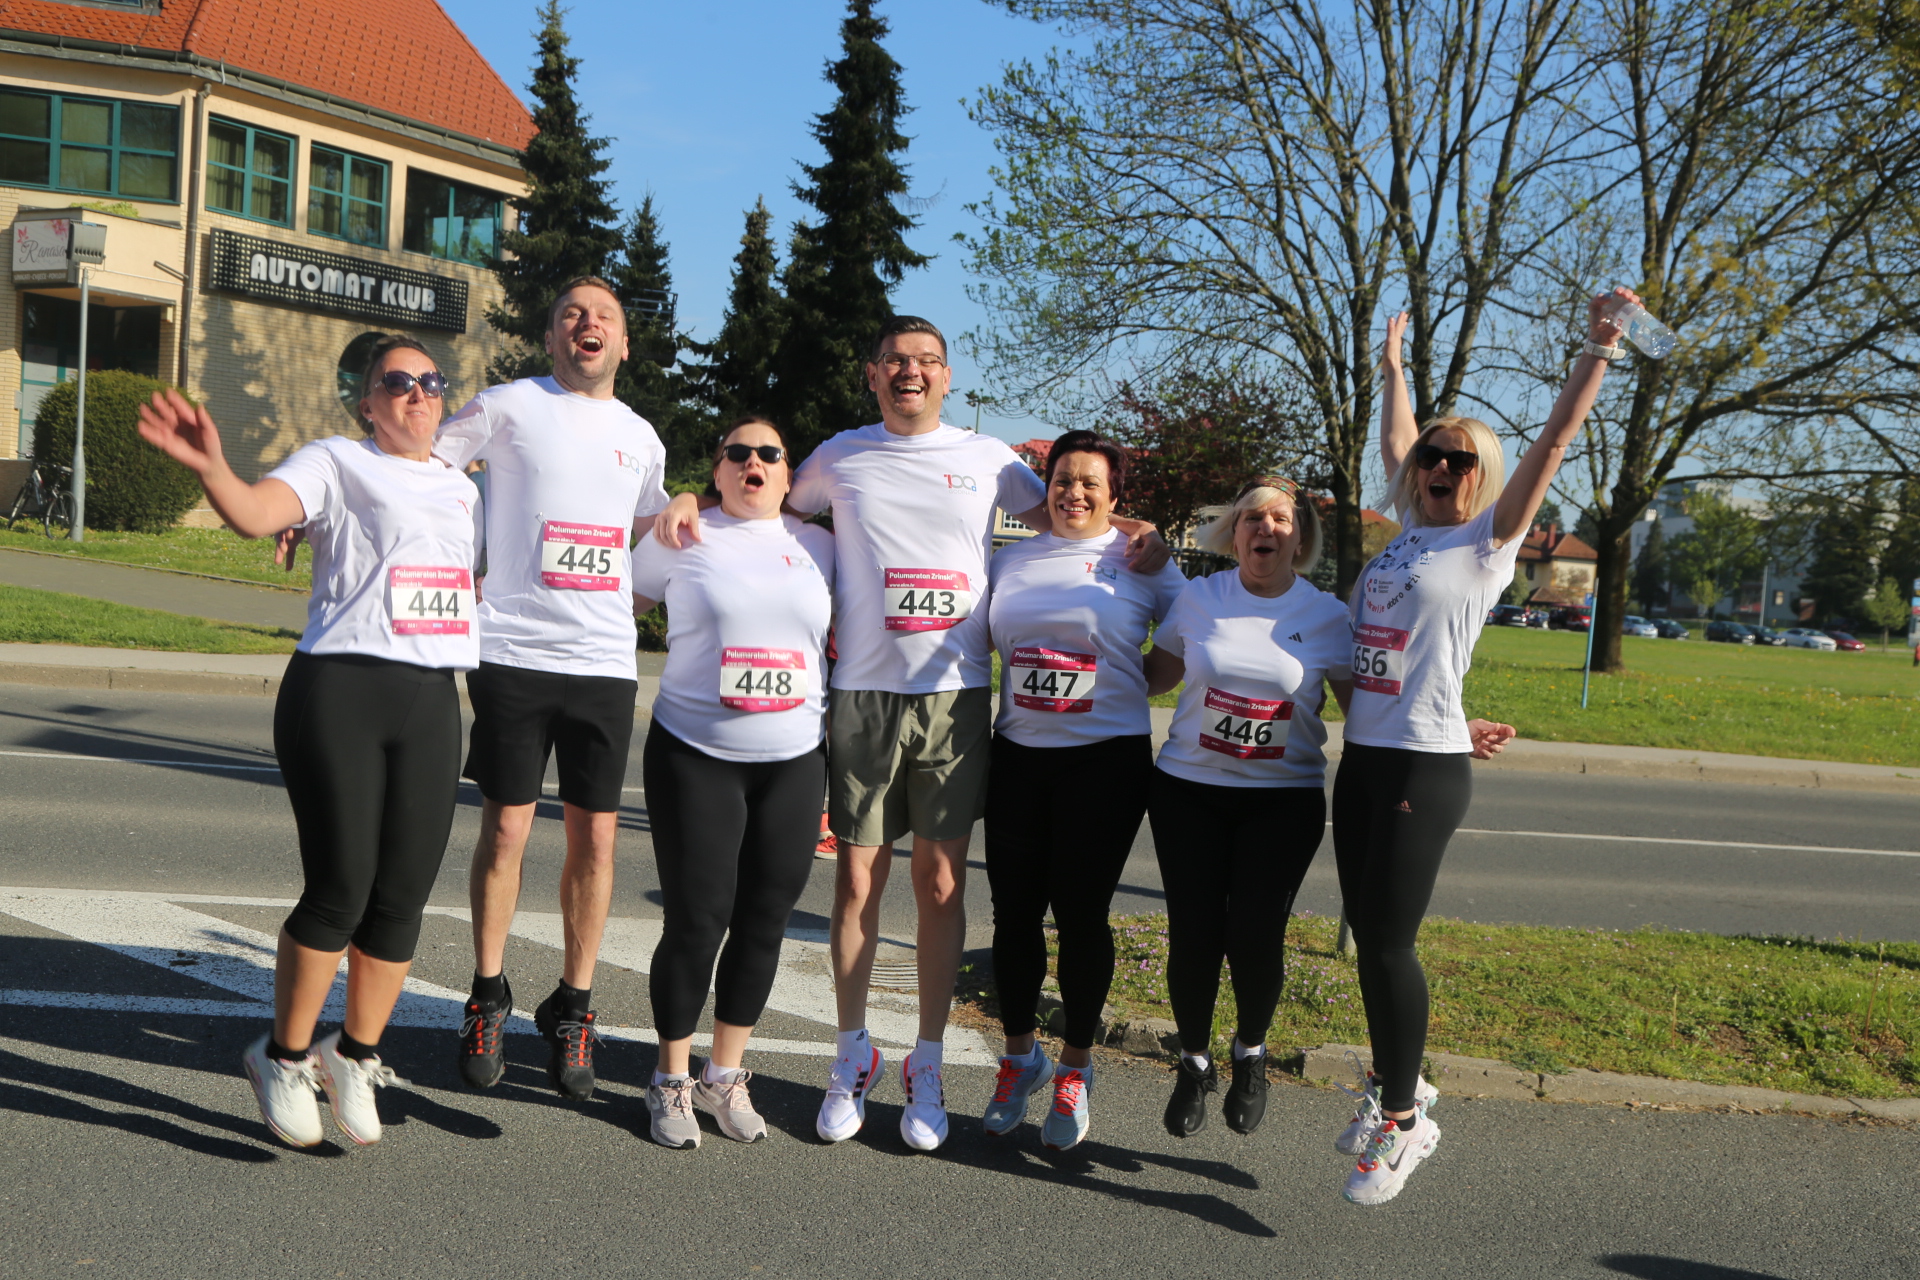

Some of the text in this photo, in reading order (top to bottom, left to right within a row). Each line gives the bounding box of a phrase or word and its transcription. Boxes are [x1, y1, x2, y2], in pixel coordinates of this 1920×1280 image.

[251, 253, 436, 312] AUTOMAT KLUB
[548, 524, 592, 536] Polumaraton
[557, 545, 611, 575] 445
[889, 572, 930, 580] Polumaraton
[408, 590, 459, 618] 444
[898, 589, 955, 616] 443
[1387, 592, 1404, 609] dobro
[726, 649, 768, 659] Polumaraton
[1015, 651, 1054, 660] Polumaraton
[1354, 646, 1387, 677] 656
[735, 670, 792, 696] 448
[1022, 669, 1078, 697] 447
[1209, 692, 1250, 709] Polumaraton
[1214, 715, 1273, 746] 446
